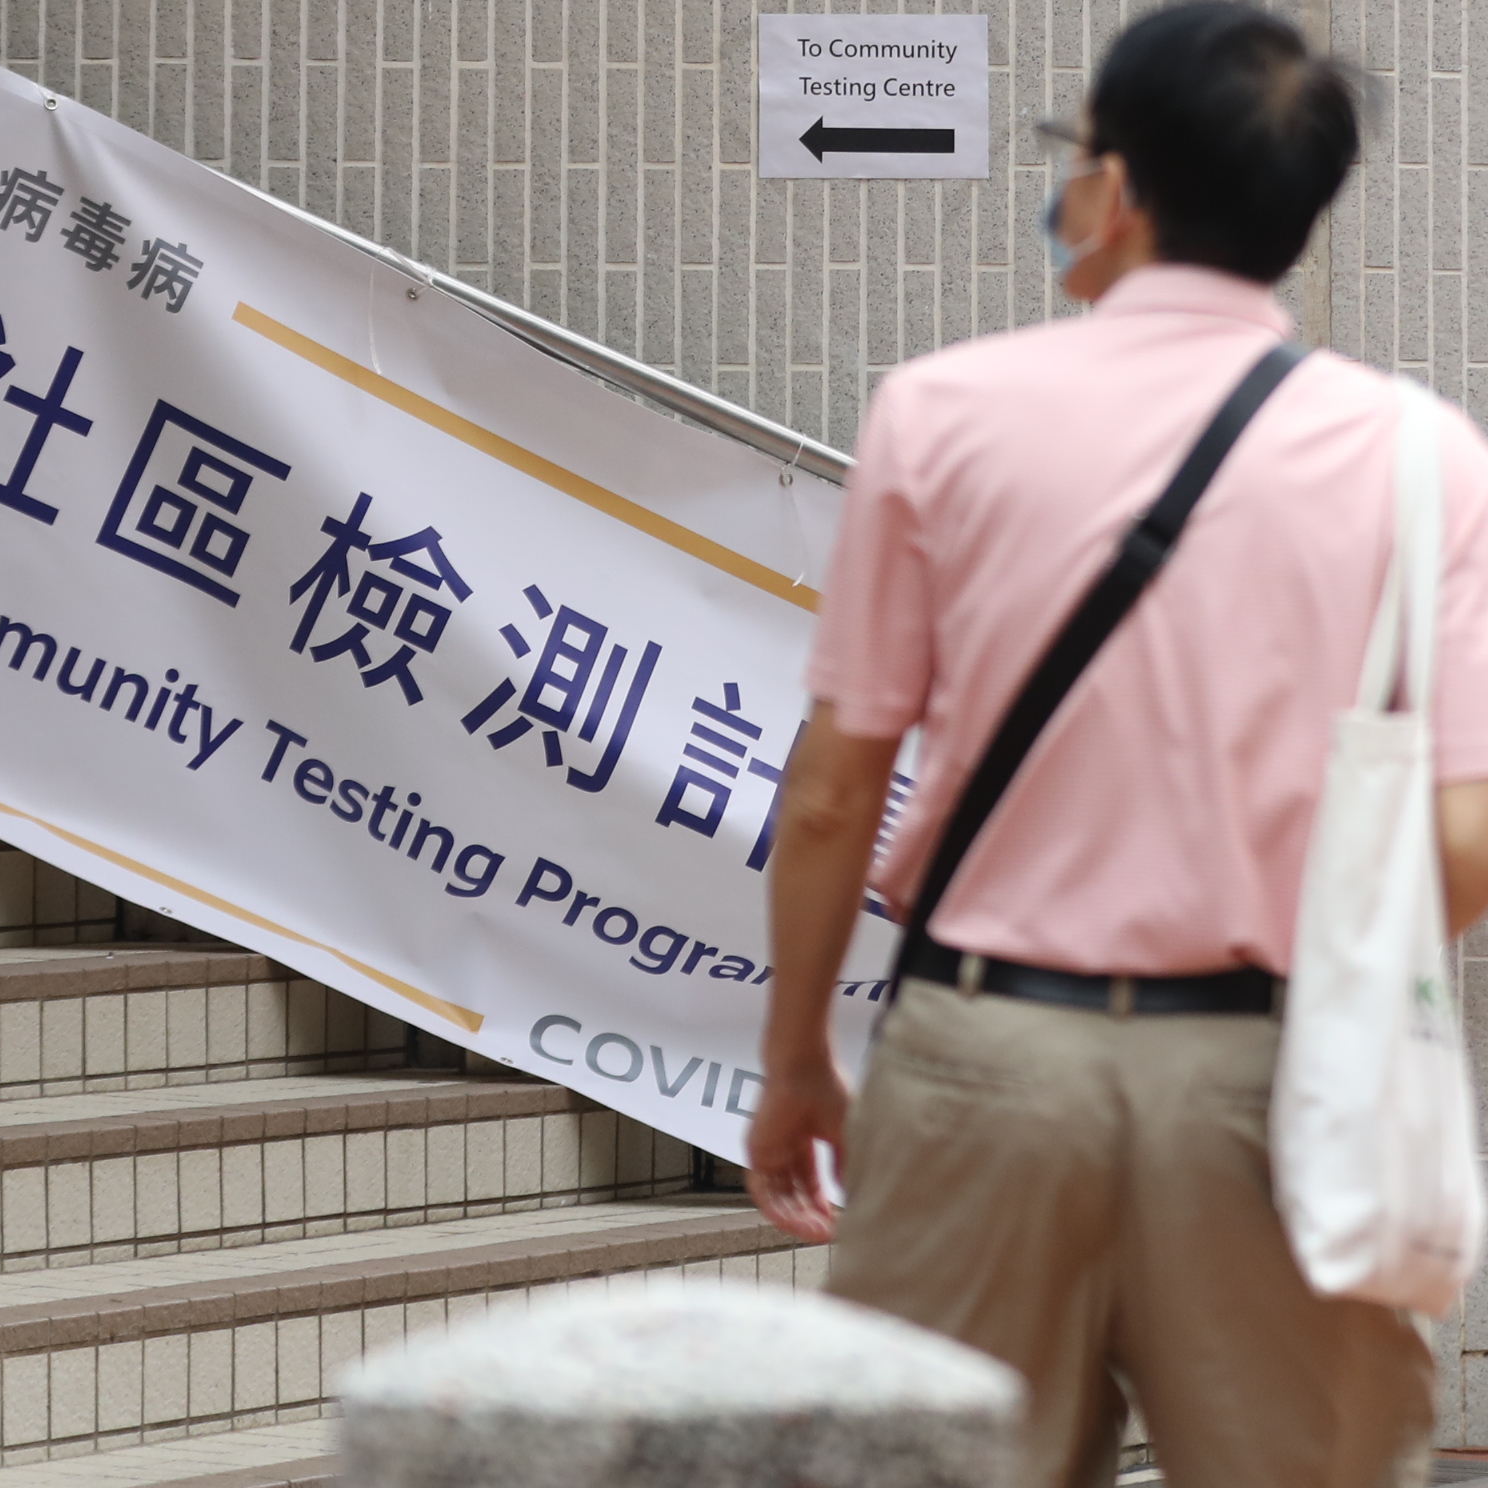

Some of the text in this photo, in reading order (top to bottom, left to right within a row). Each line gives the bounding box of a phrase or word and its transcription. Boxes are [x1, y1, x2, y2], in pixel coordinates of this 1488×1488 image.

[797, 37, 958, 63] To Community
[798, 76, 956, 102] Testing Centre
[260, 718, 505, 899] Testing
